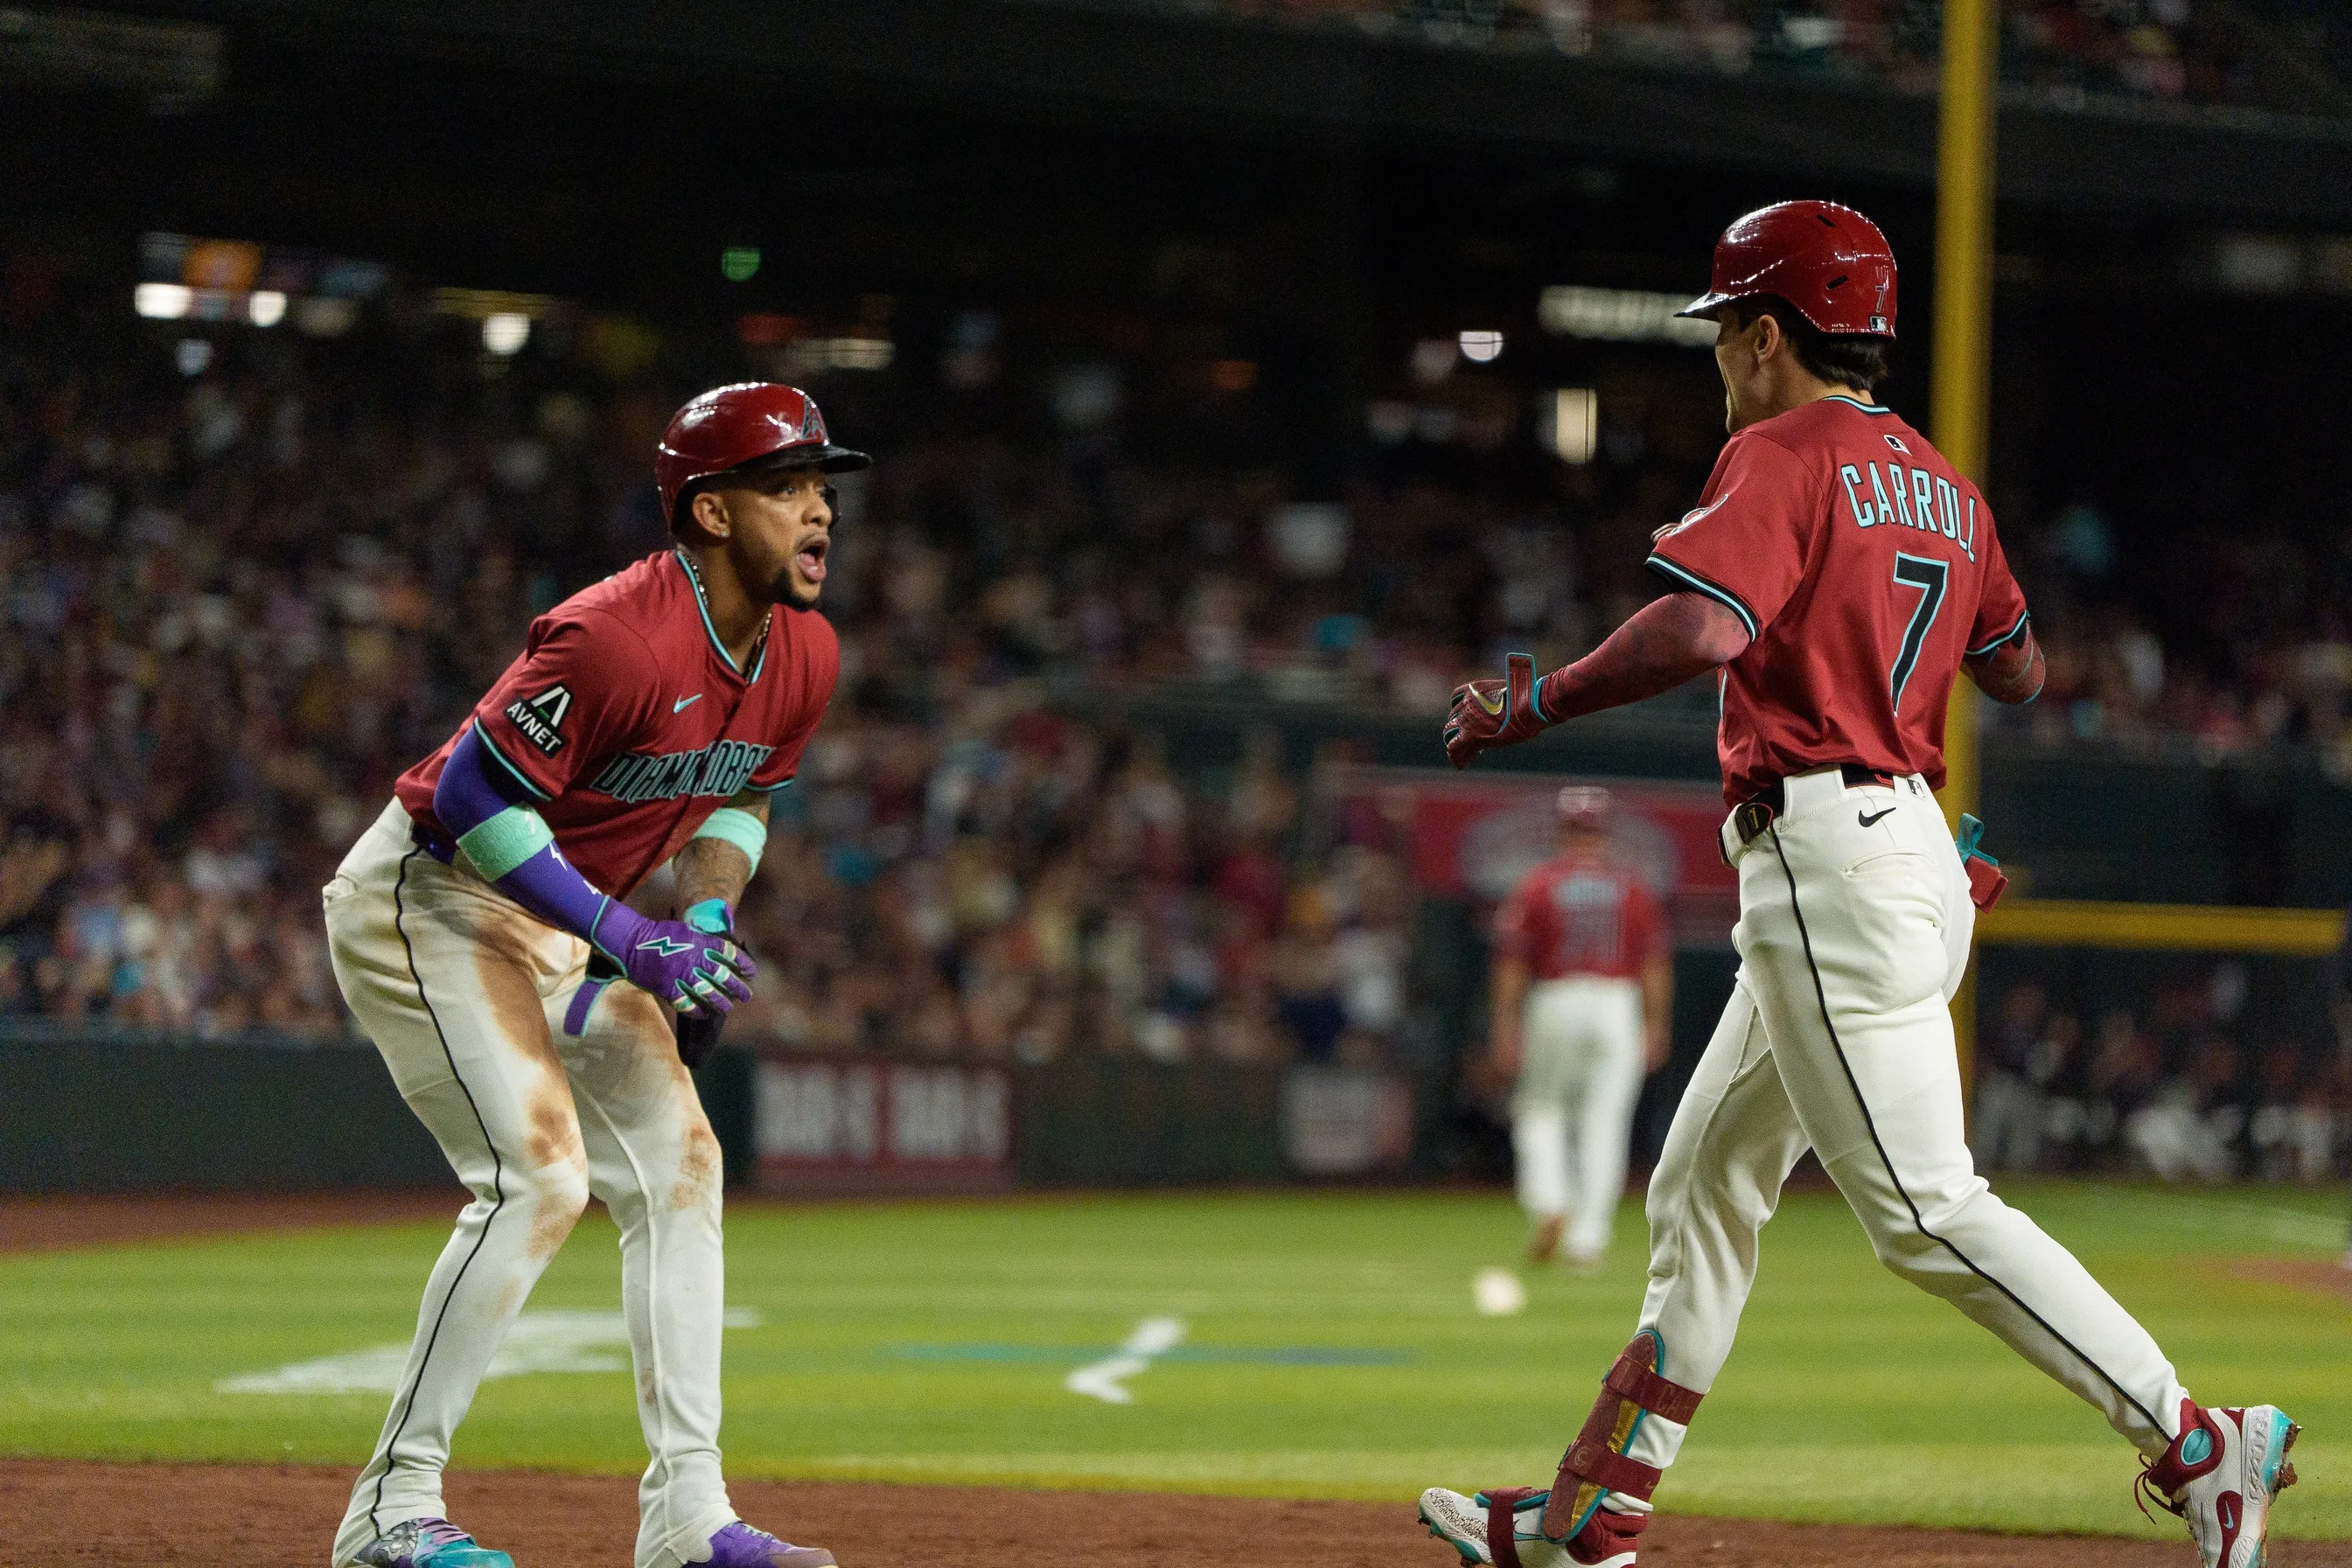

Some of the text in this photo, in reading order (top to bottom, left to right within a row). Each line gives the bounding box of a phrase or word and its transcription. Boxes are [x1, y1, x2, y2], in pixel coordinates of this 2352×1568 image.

[1840, 460, 1976, 563] CARROLL
[1890, 550, 1950, 718] 7
[506, 701, 562, 751] AVNET
